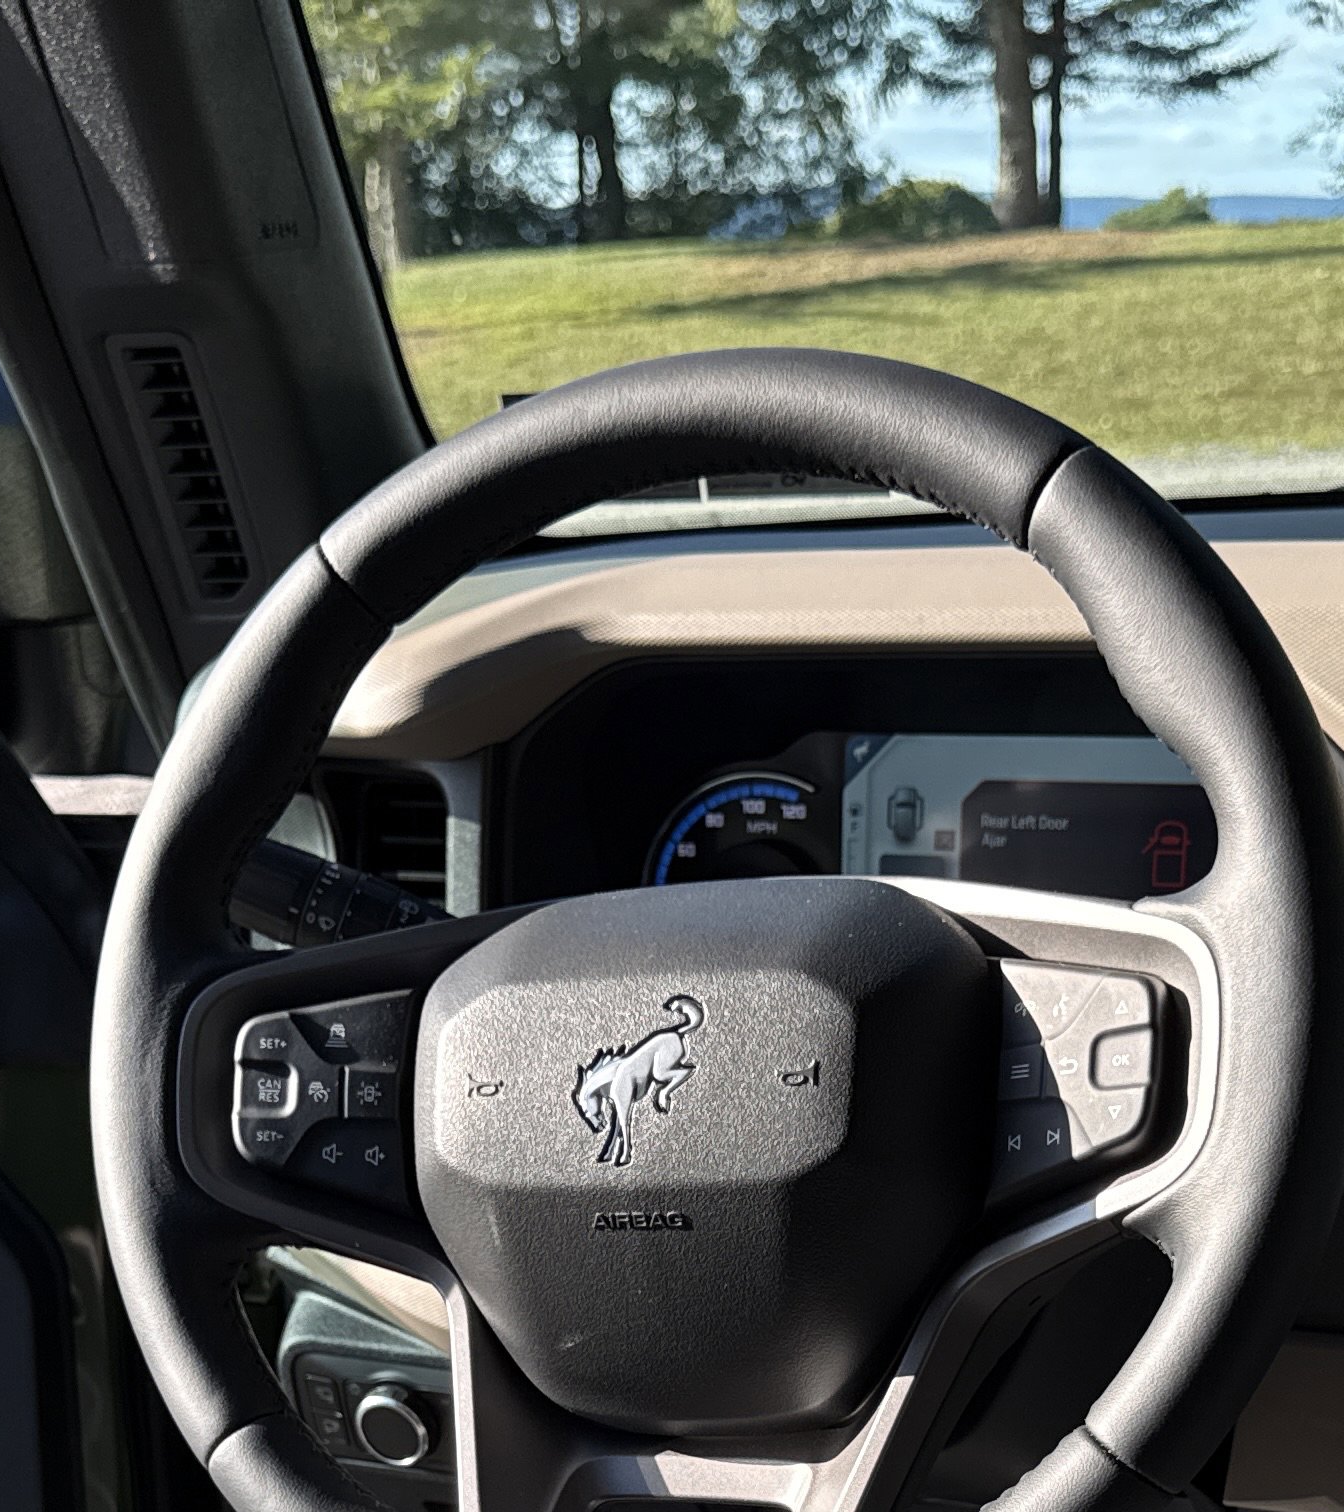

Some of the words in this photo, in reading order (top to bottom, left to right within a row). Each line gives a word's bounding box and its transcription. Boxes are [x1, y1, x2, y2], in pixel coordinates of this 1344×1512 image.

[746, 820, 778, 834] MPH
[980, 812, 1009, 829] Rear
[1010, 814, 1036, 830] Left
[1037, 814, 1070, 831] Door
[1112, 1054, 1130, 1067] OK
[257, 1078, 282, 1089] CAN
[258, 1093, 280, 1103] RES
[591, 1210, 691, 1231] AIRBAG
